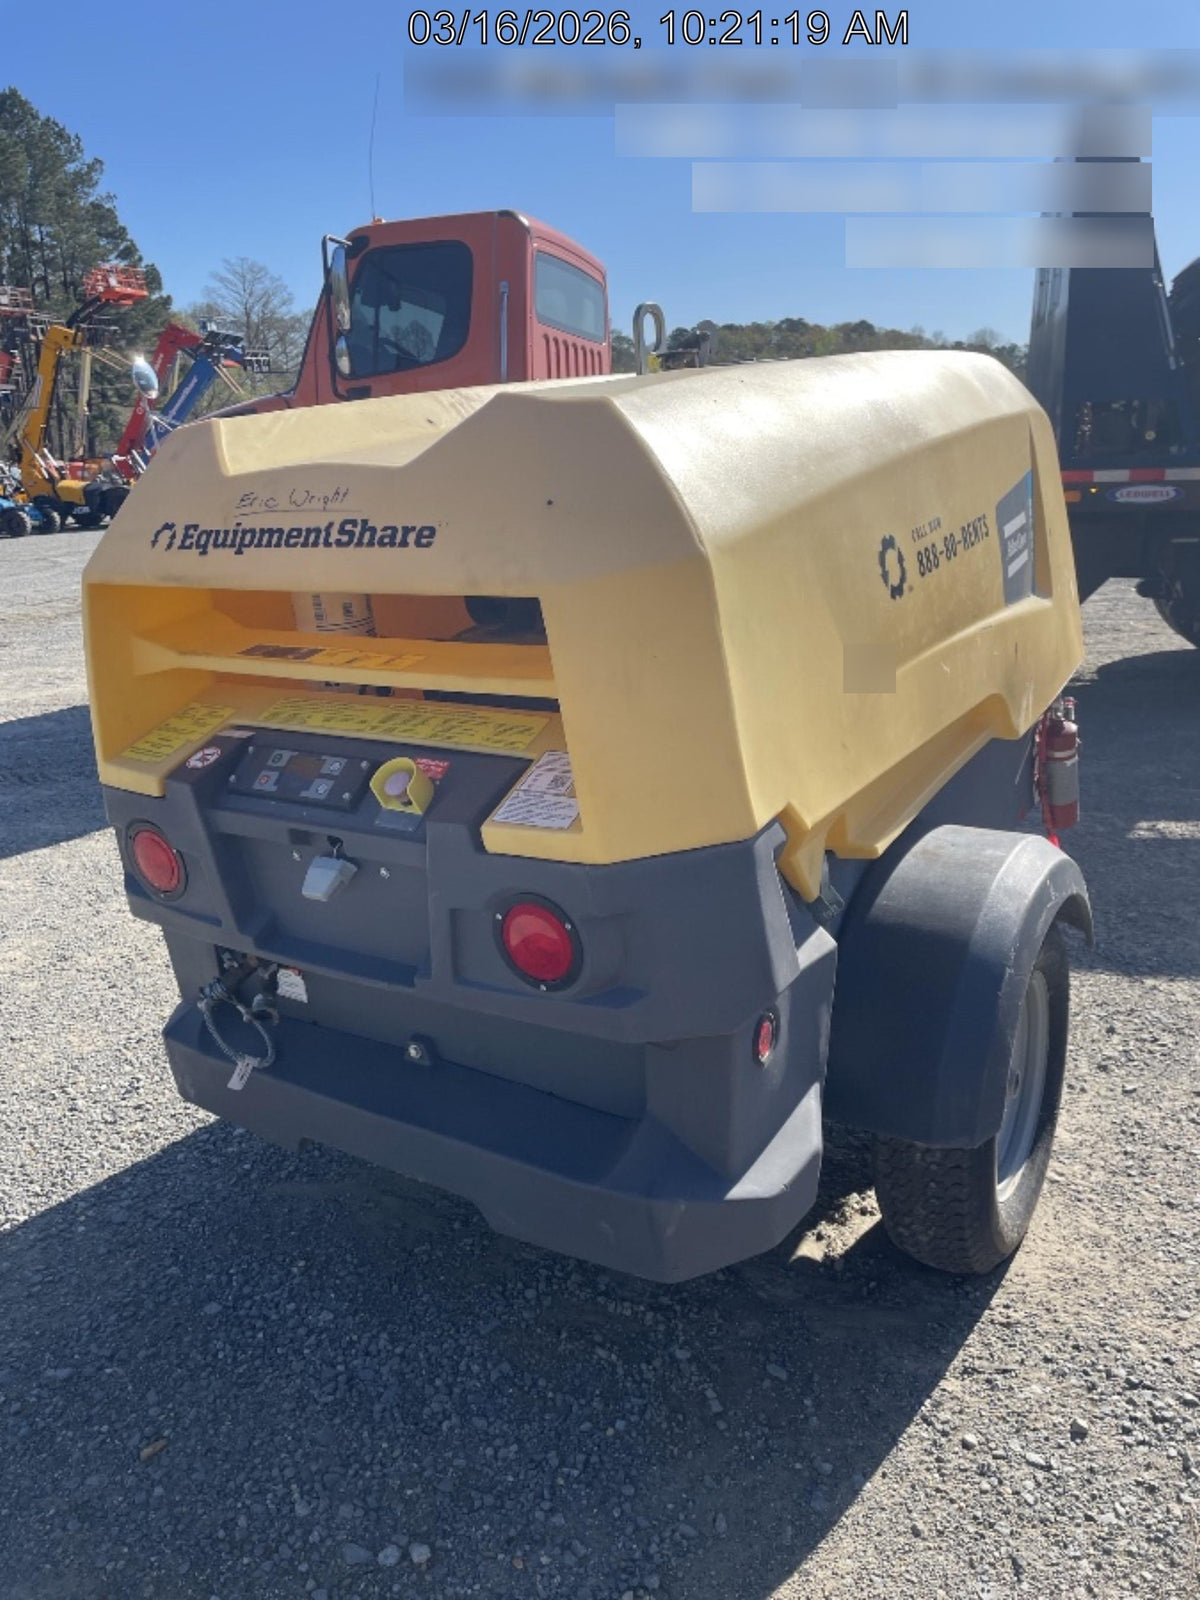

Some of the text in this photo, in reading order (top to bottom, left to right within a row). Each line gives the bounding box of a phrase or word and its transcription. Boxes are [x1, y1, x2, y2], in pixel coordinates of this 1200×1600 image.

[235, 486, 350, 512] Eric Wright
[176, 517, 437, 557] EquipmentShare
[916, 513, 990, 578] 888-80-RENTS
